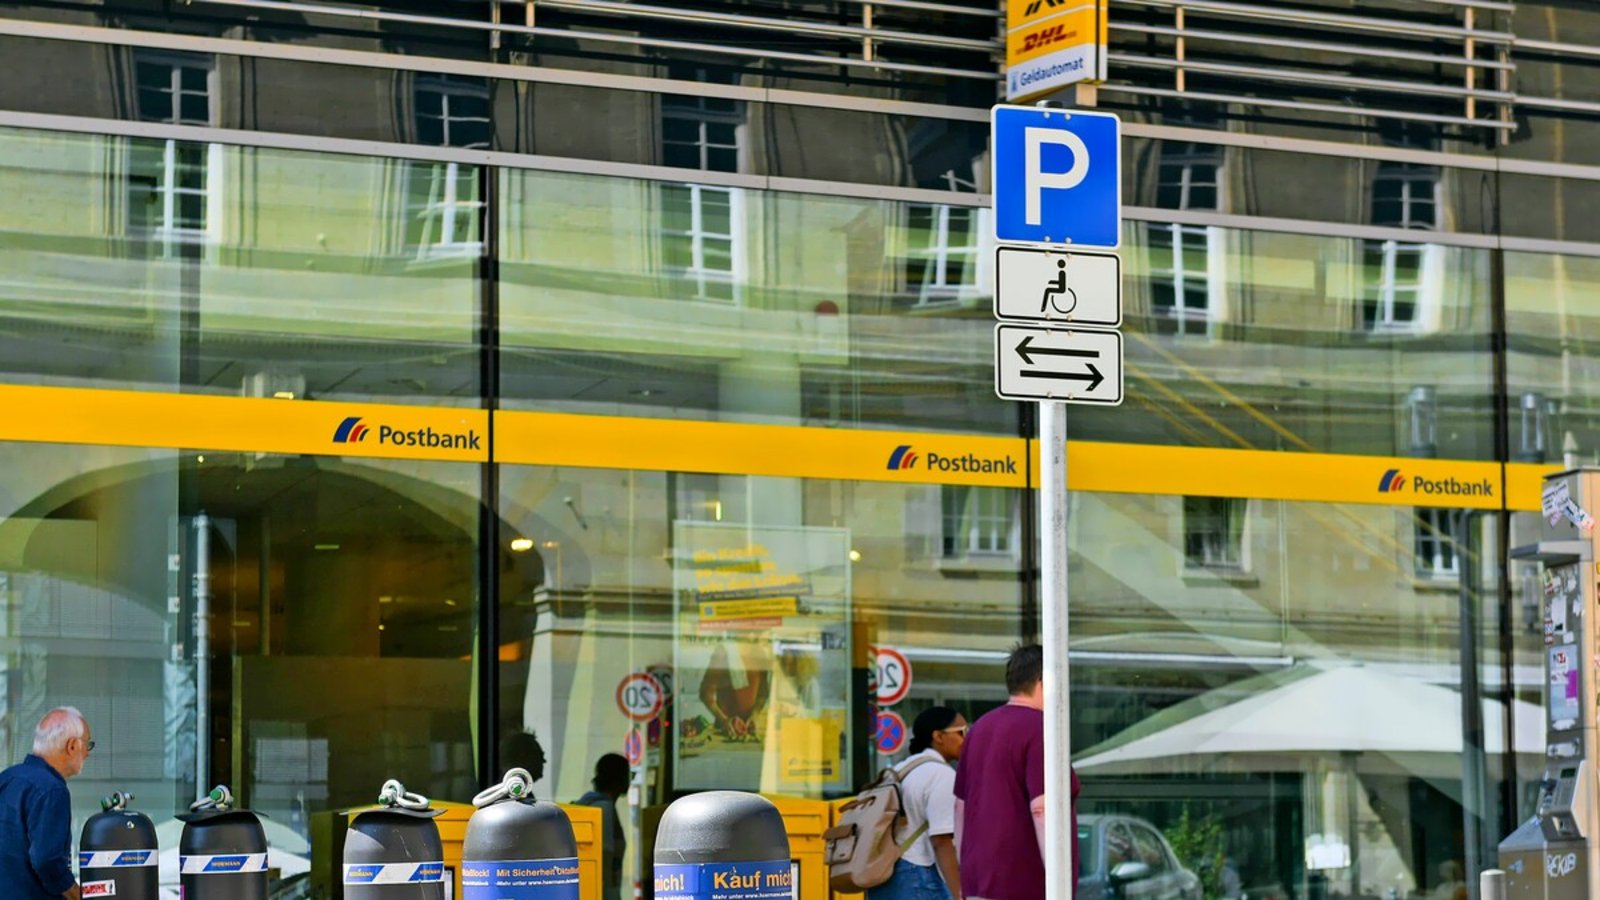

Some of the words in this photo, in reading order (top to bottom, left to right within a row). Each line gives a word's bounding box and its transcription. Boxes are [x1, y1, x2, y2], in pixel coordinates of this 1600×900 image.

[1024, 24, 1065, 51] DHL
[1020, 57, 1084, 86] Geldautomat
[1025, 126, 1090, 226] P
[380, 425, 481, 450] Postbank
[927, 452, 1017, 474] Postbank
[1414, 476, 1492, 496] Postbank
[496, 869, 511, 877] Mit
[512, 867, 555, 877] Sicherheit
[713, 870, 761, 890] Kauf
